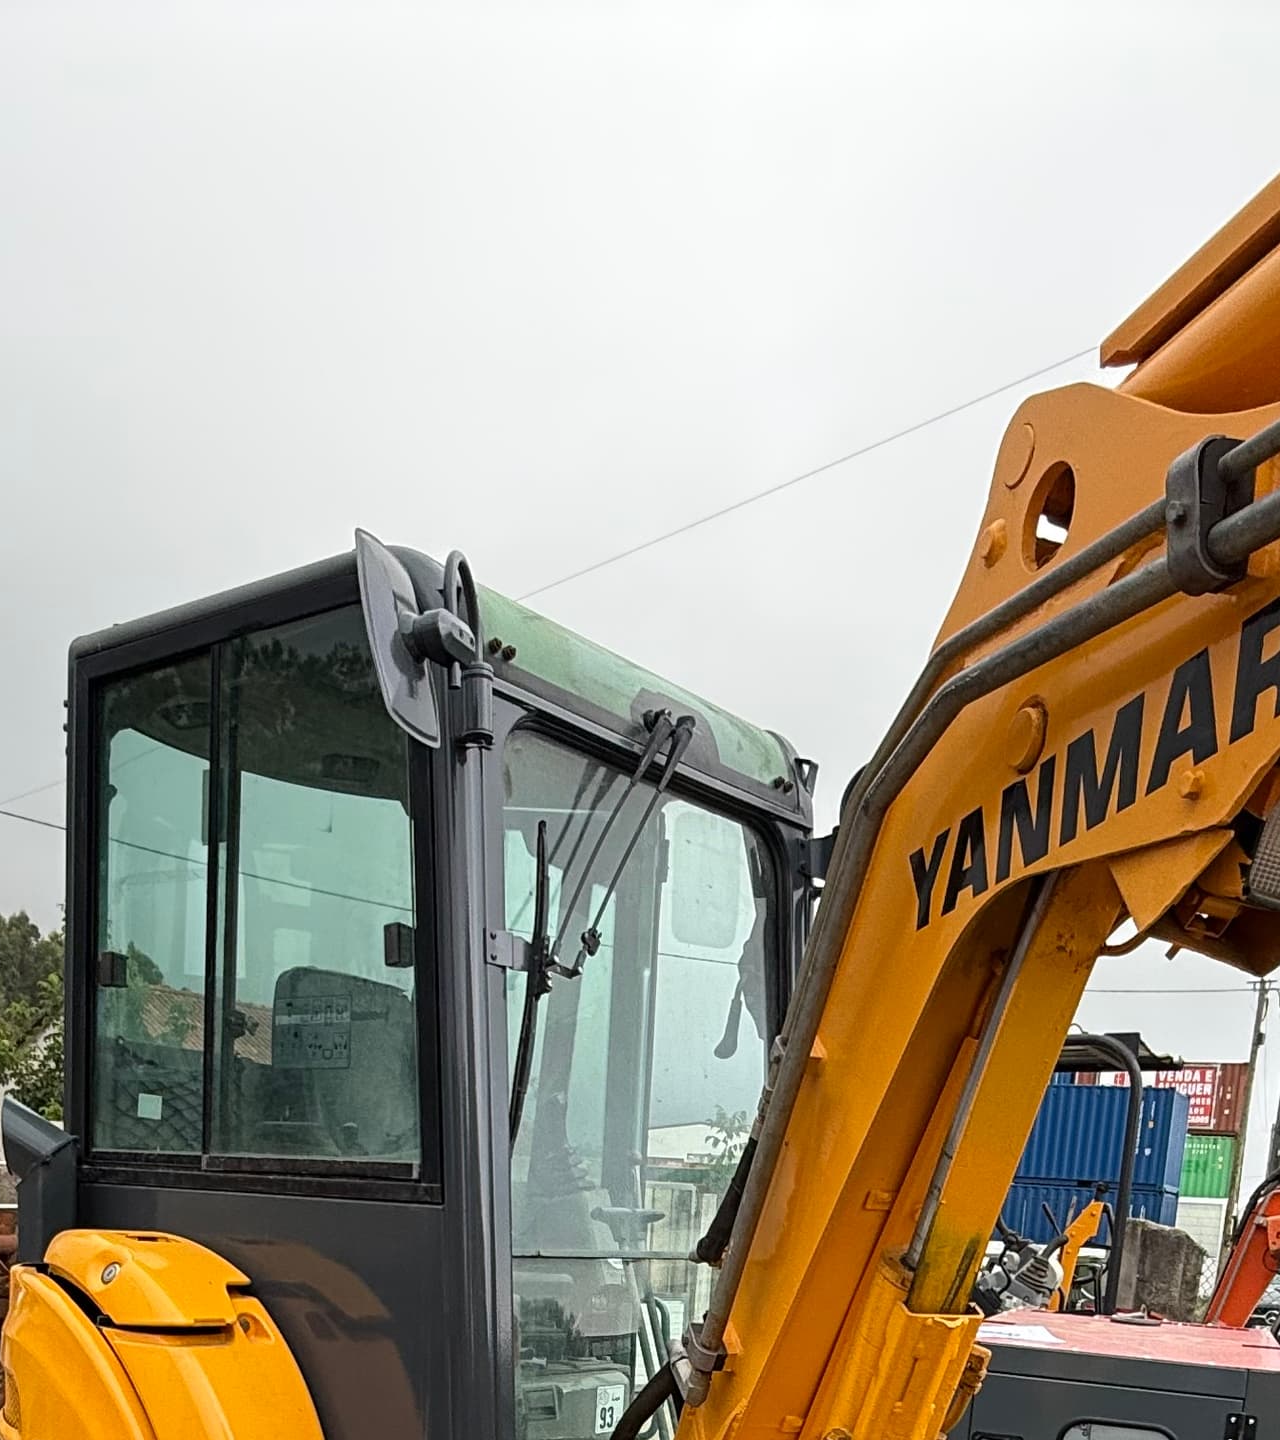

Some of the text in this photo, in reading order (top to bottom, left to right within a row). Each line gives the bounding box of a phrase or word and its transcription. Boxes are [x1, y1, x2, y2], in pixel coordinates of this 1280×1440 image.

[1158, 1069, 1213, 1082] VENDA E
[600, 1406, 614, 1429] 93
